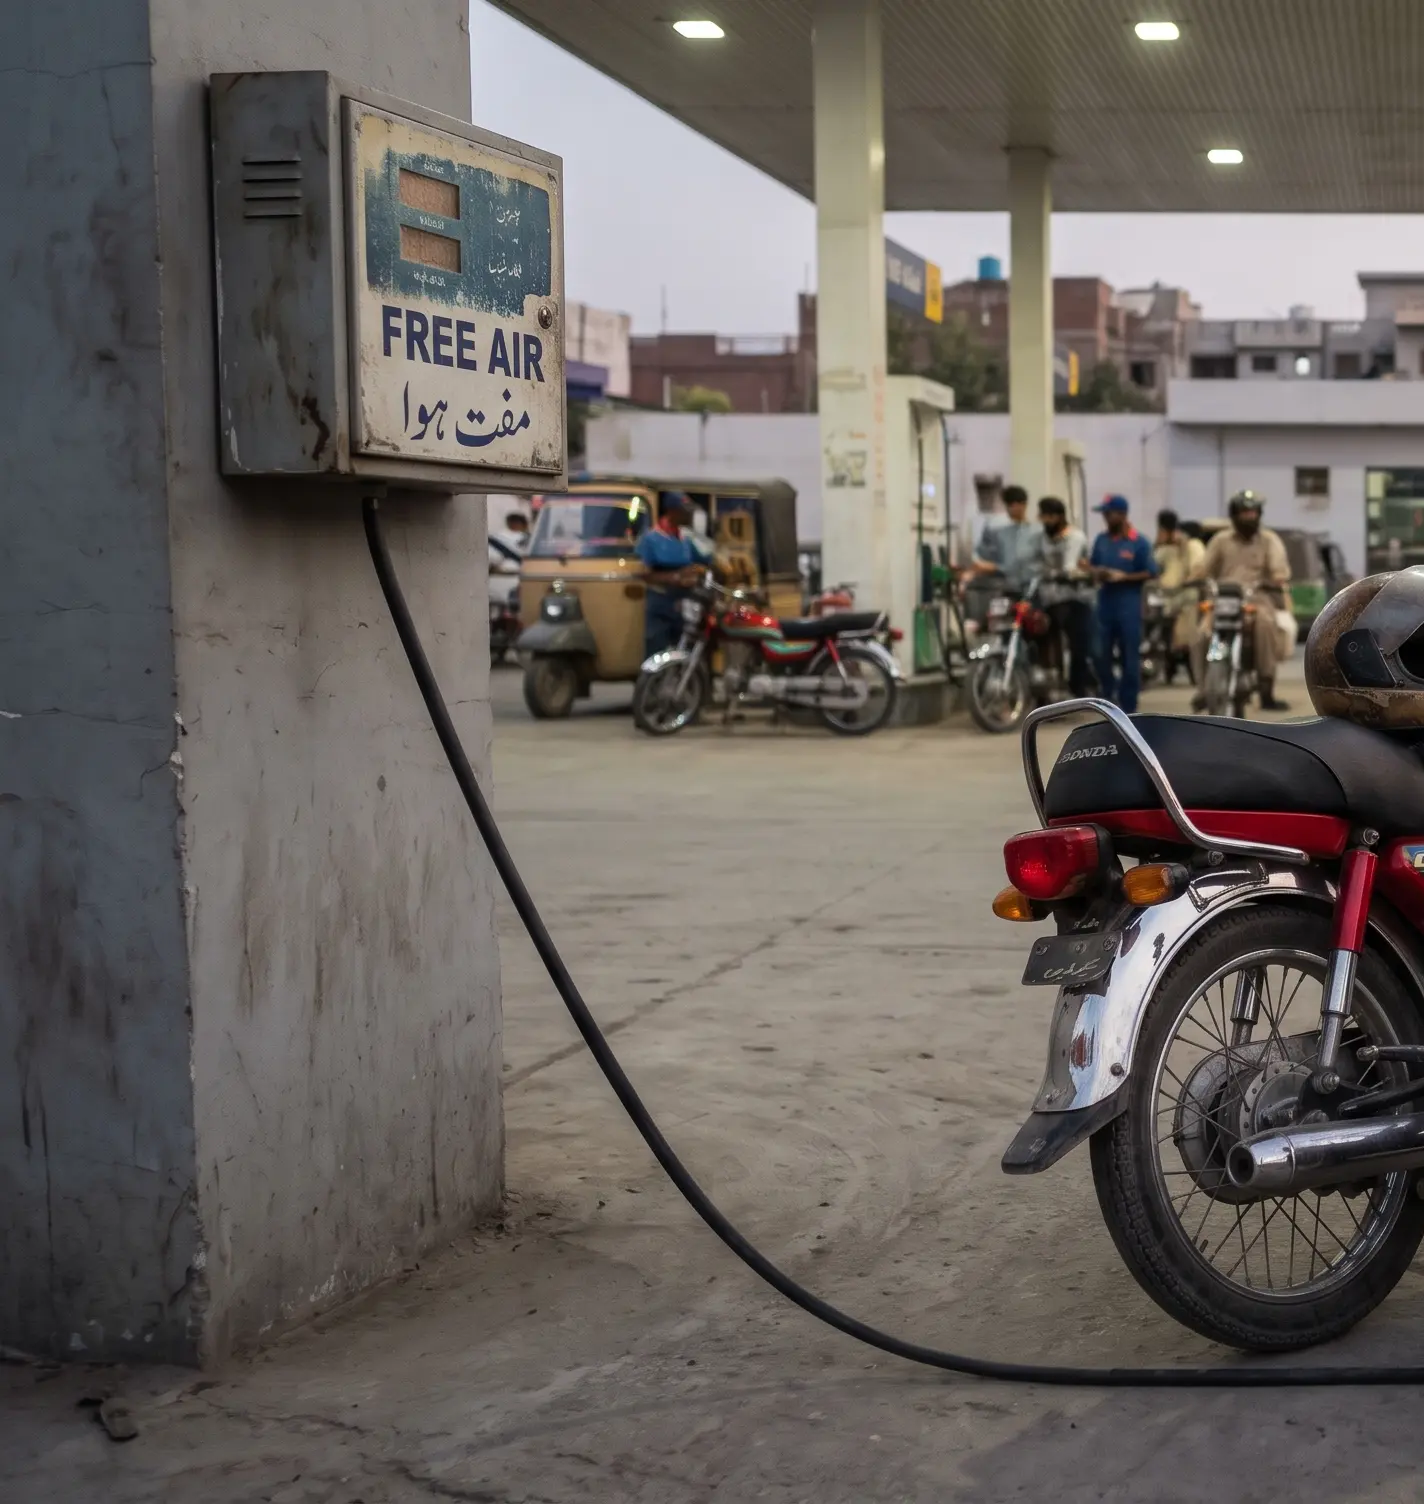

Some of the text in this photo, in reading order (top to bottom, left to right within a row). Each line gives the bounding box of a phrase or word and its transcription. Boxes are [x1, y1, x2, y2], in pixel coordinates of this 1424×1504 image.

[382, 305, 545, 382] FREE AIR
[403, 381, 531, 447] مفت ہوا
